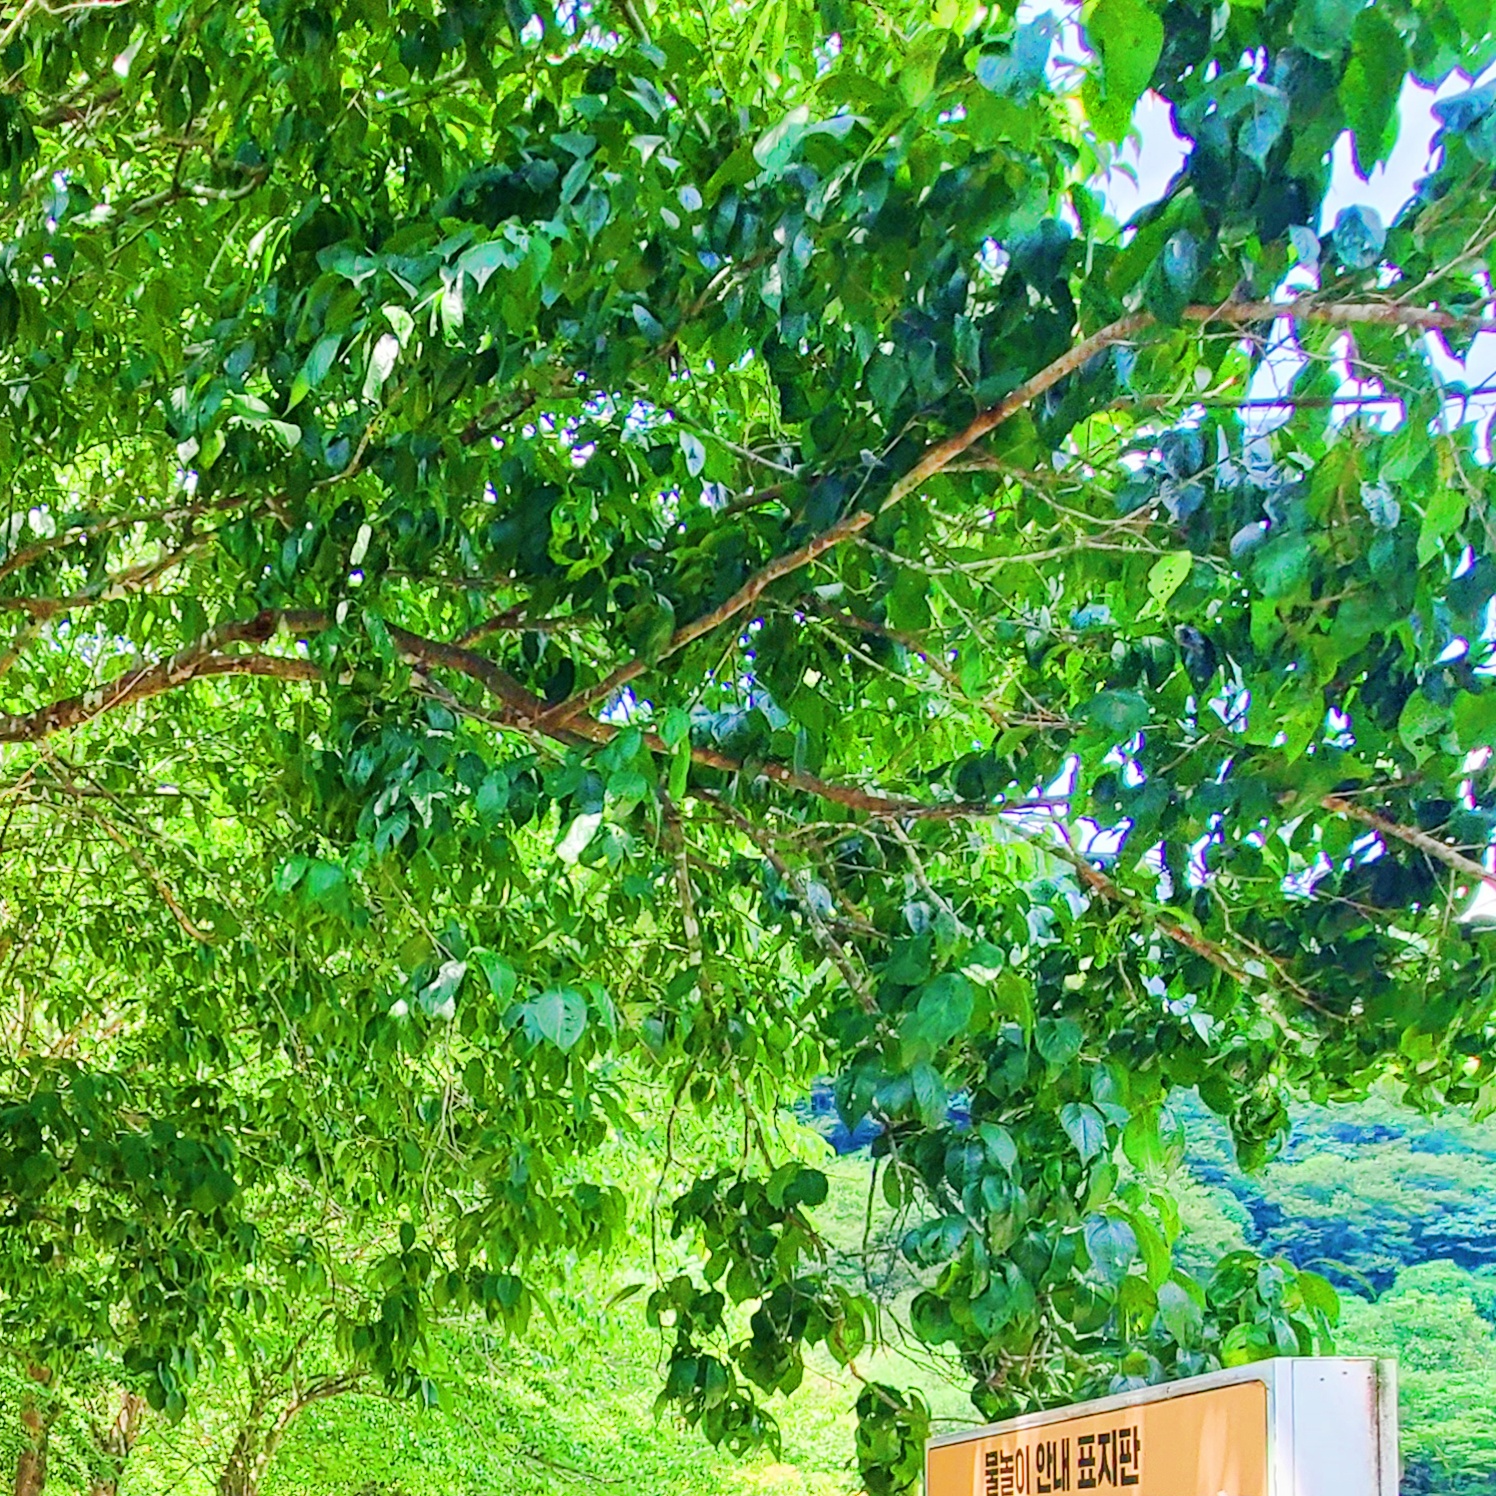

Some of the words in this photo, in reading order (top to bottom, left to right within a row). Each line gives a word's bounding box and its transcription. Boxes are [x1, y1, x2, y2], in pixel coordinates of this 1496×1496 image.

[985, 1445, 1029, 1496] 물놀이
[1035, 1438, 1069, 1492] 안내
[1077, 1427, 1140, 1489] 표지판
